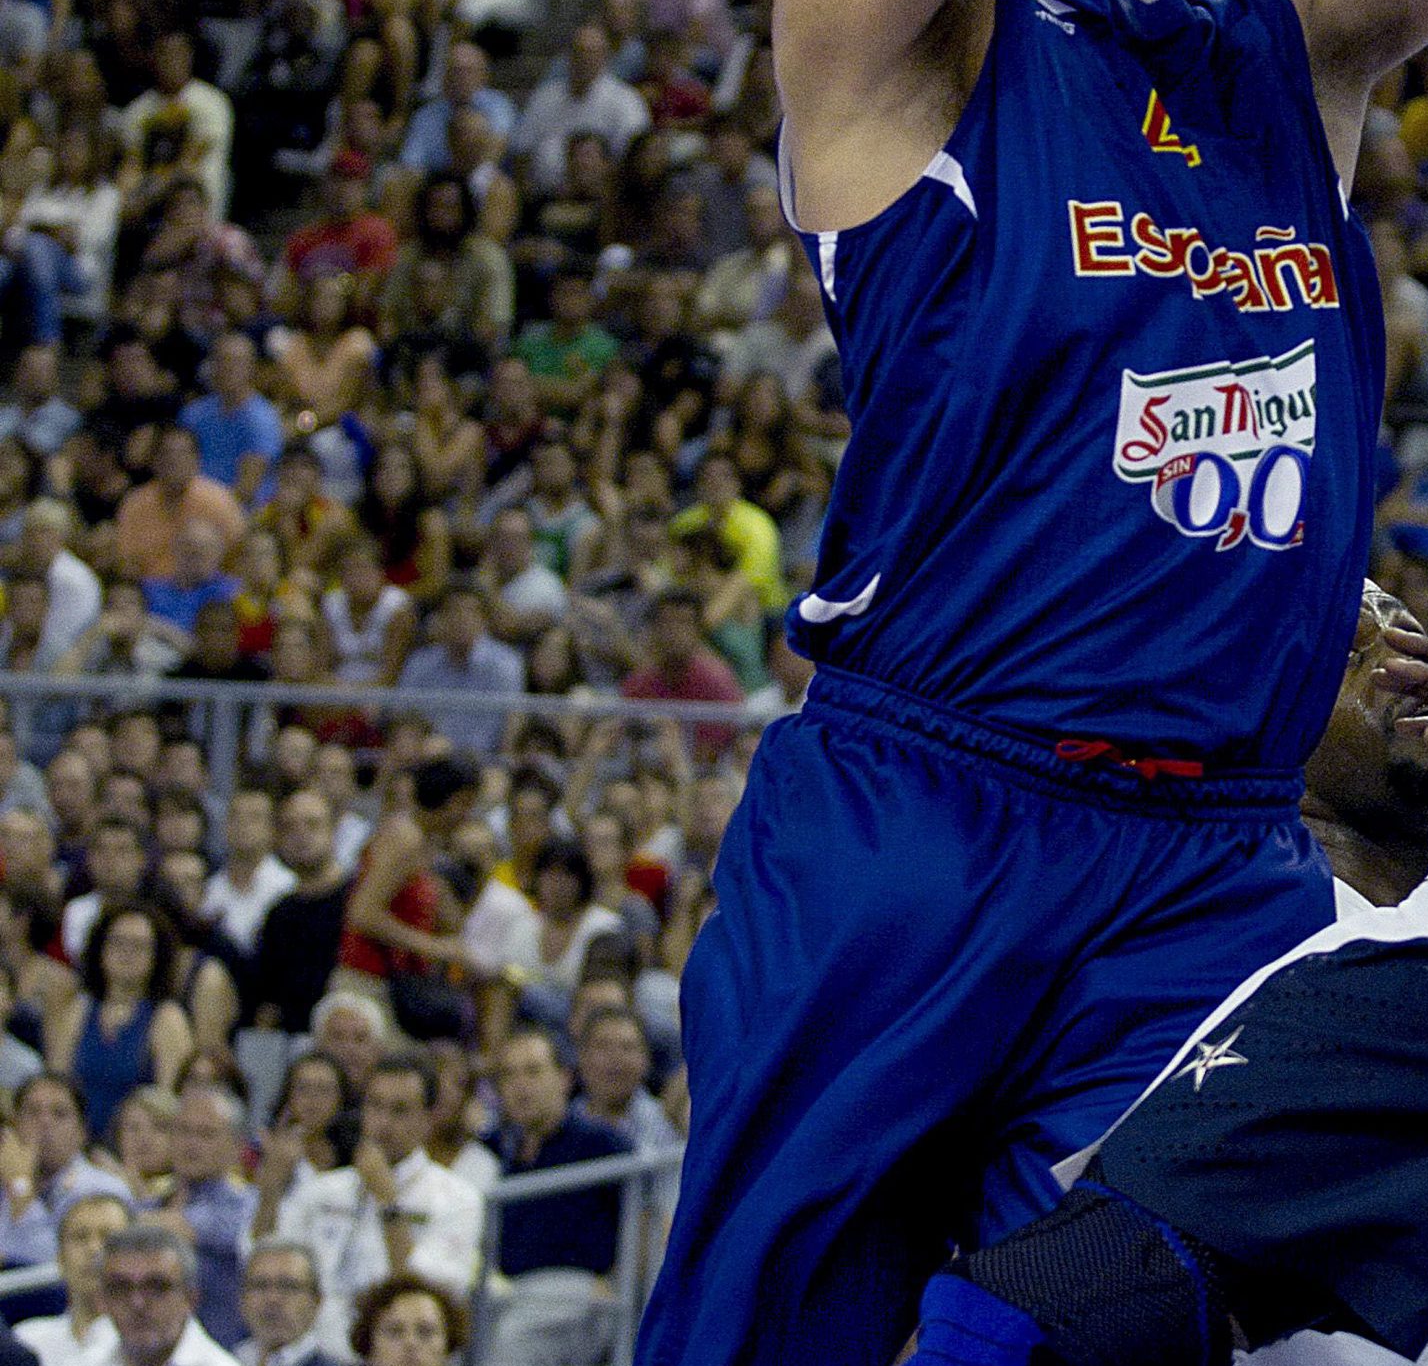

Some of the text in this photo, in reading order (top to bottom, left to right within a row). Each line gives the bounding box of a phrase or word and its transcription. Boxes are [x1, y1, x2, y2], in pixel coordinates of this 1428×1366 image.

[1121, 382, 1316, 462] San Migu
[1163, 457, 1191, 482] SIN
